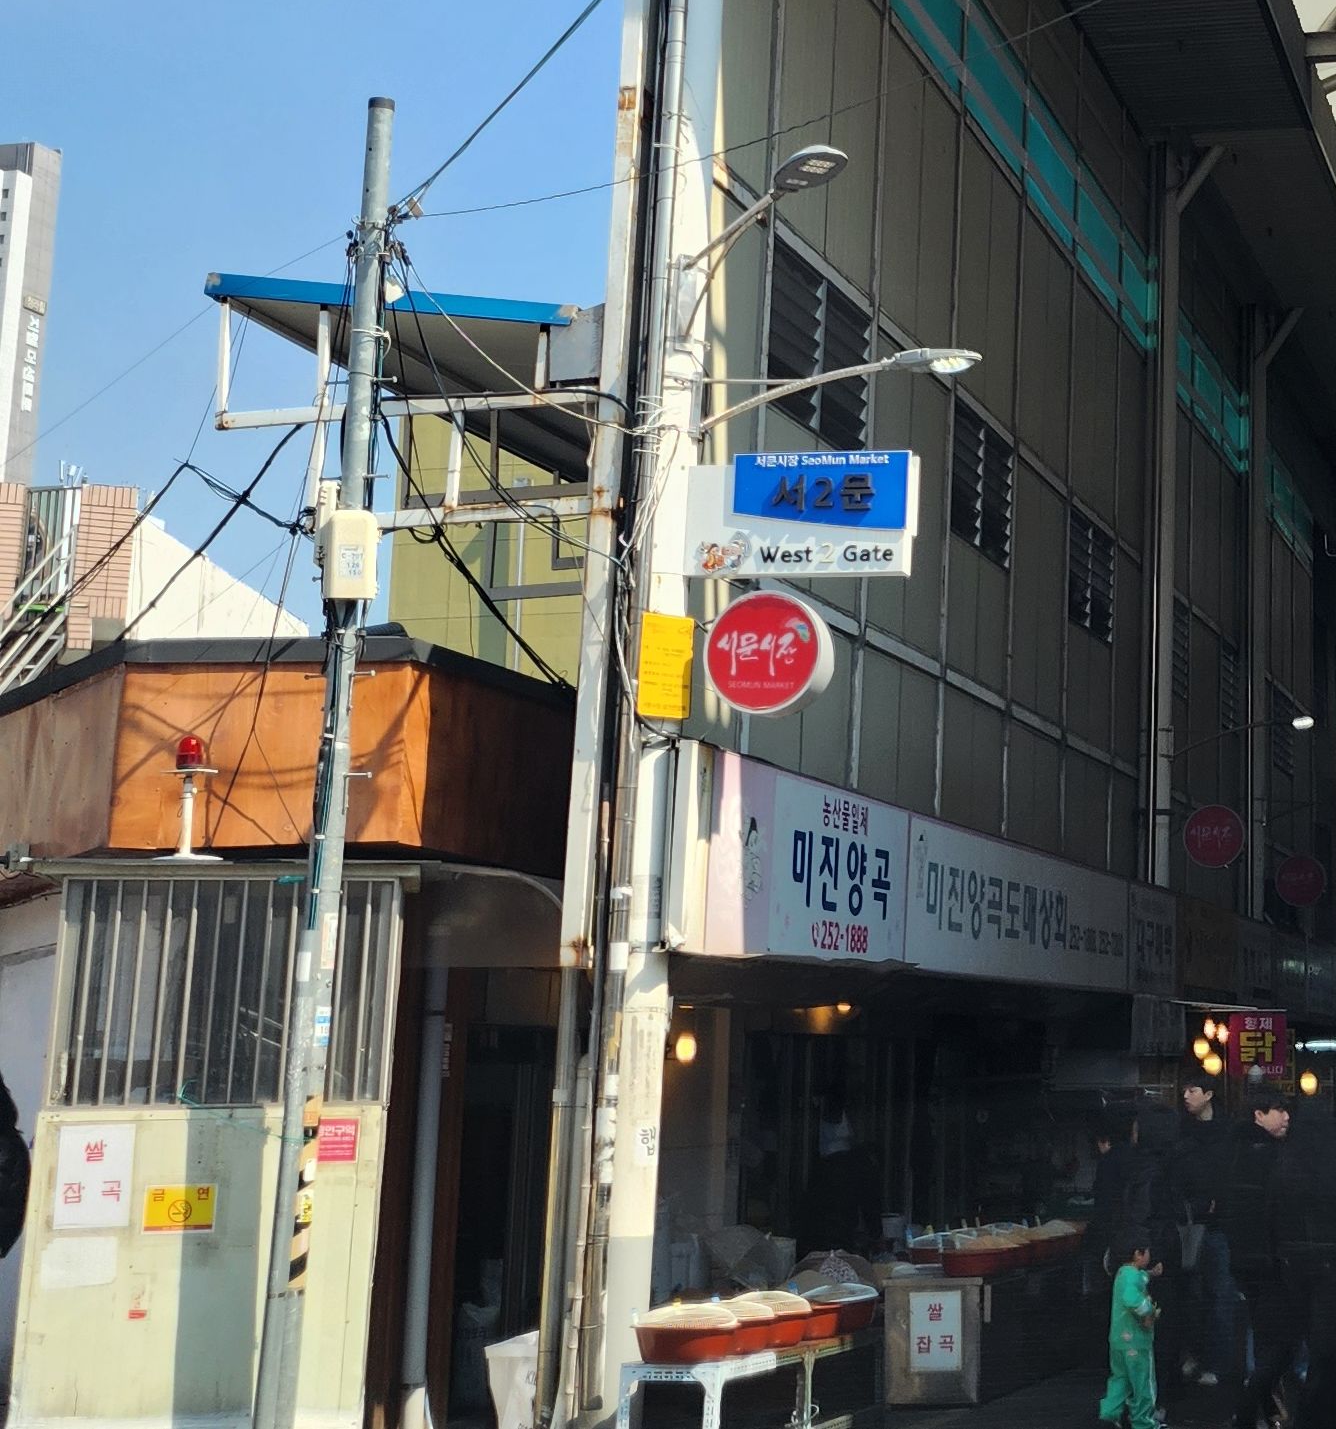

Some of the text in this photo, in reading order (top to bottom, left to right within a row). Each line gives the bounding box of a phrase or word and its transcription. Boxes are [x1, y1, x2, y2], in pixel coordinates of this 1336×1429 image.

[755, 452, 890, 468] 서문시장 SeoMun Market
[760, 543, 895, 564] West 2 Gate
[716, 632, 797, 677] 서문시장
[822, 794, 869, 837] 농산물일체
[791, 829, 891, 921] 미진양곡
[925, 862, 1068, 951] 미진양곡도매상회
[820, 920, 869, 954] 252-1888
[1239, 1031, 1276, 1063] 닭
[84, 1139, 107, 1162] 쌀
[926, 1302, 944, 1322] 쌀
